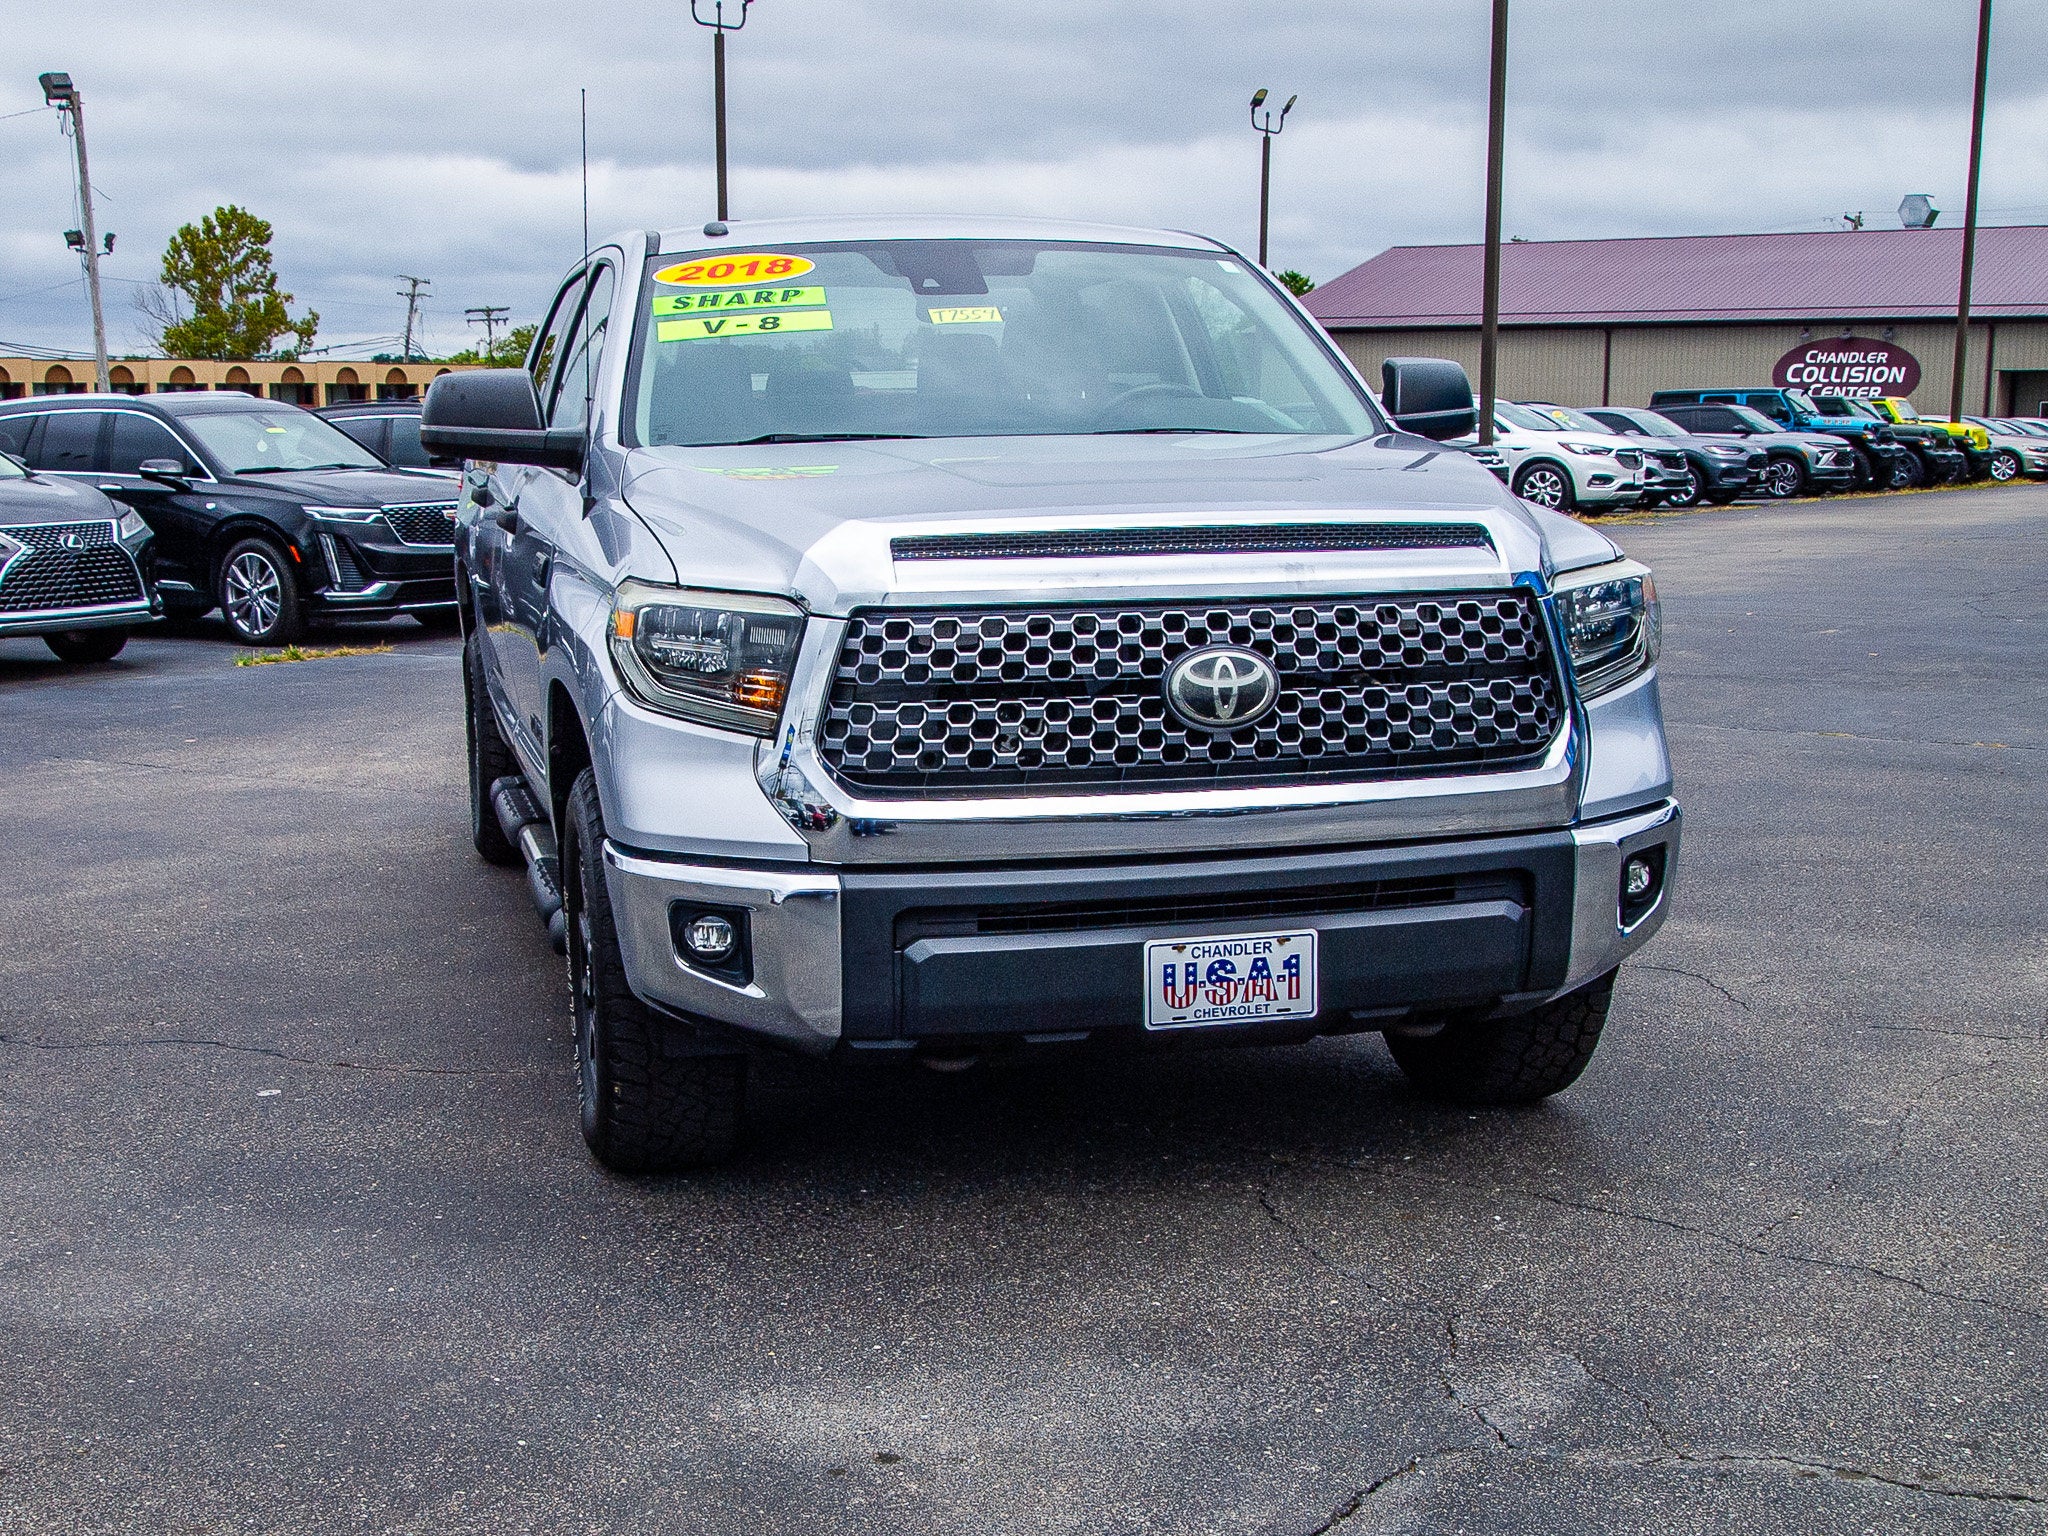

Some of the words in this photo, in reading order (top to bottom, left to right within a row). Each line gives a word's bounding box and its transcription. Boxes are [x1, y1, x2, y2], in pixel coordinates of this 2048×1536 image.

[674, 258, 794, 283] 2018
[672, 289, 802, 311] SHARP
[1805, 350, 1888, 364] CHANDLER
[1786, 363, 1907, 383] COLLISION
[1809, 384, 1882, 397] CENTER
[1191, 941, 1273, 959] CHANDLER
[1193, 1003, 1271, 1019] CHEVROLET
